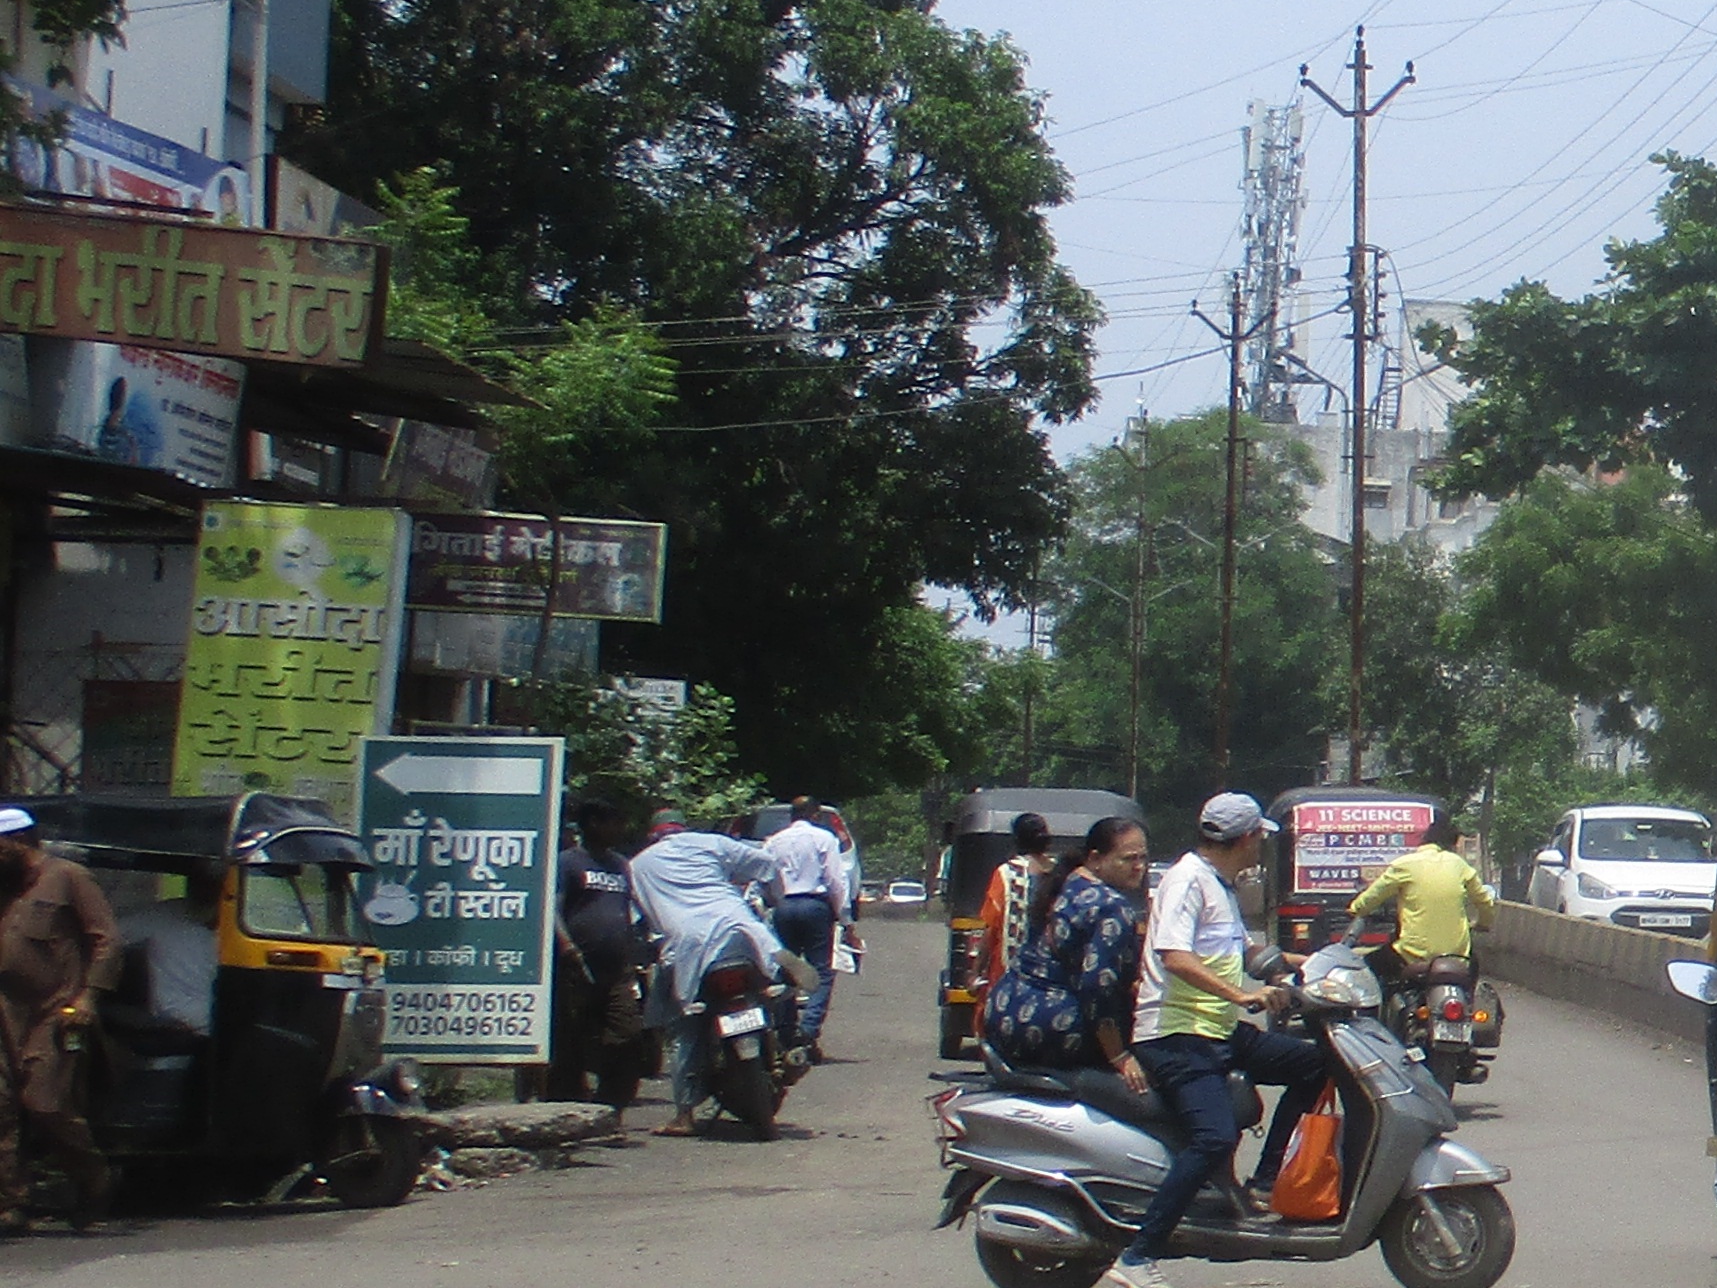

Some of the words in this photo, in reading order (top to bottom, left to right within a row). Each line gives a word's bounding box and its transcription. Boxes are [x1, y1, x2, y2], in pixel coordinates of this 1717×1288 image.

[1341, 810, 1412, 821] SCIENCE
[372, 809, 426, 866] माँ
[428, 817, 538, 881] रेणूका
[1308, 868, 1360, 880] WAVES
[424, 881, 452, 919] टी
[456, 882, 529, 920] स्टॉल
[494, 949, 524, 973] दूध
[391, 992, 536, 1013] 9404706162
[391, 1015, 533, 1037] 7030496162
